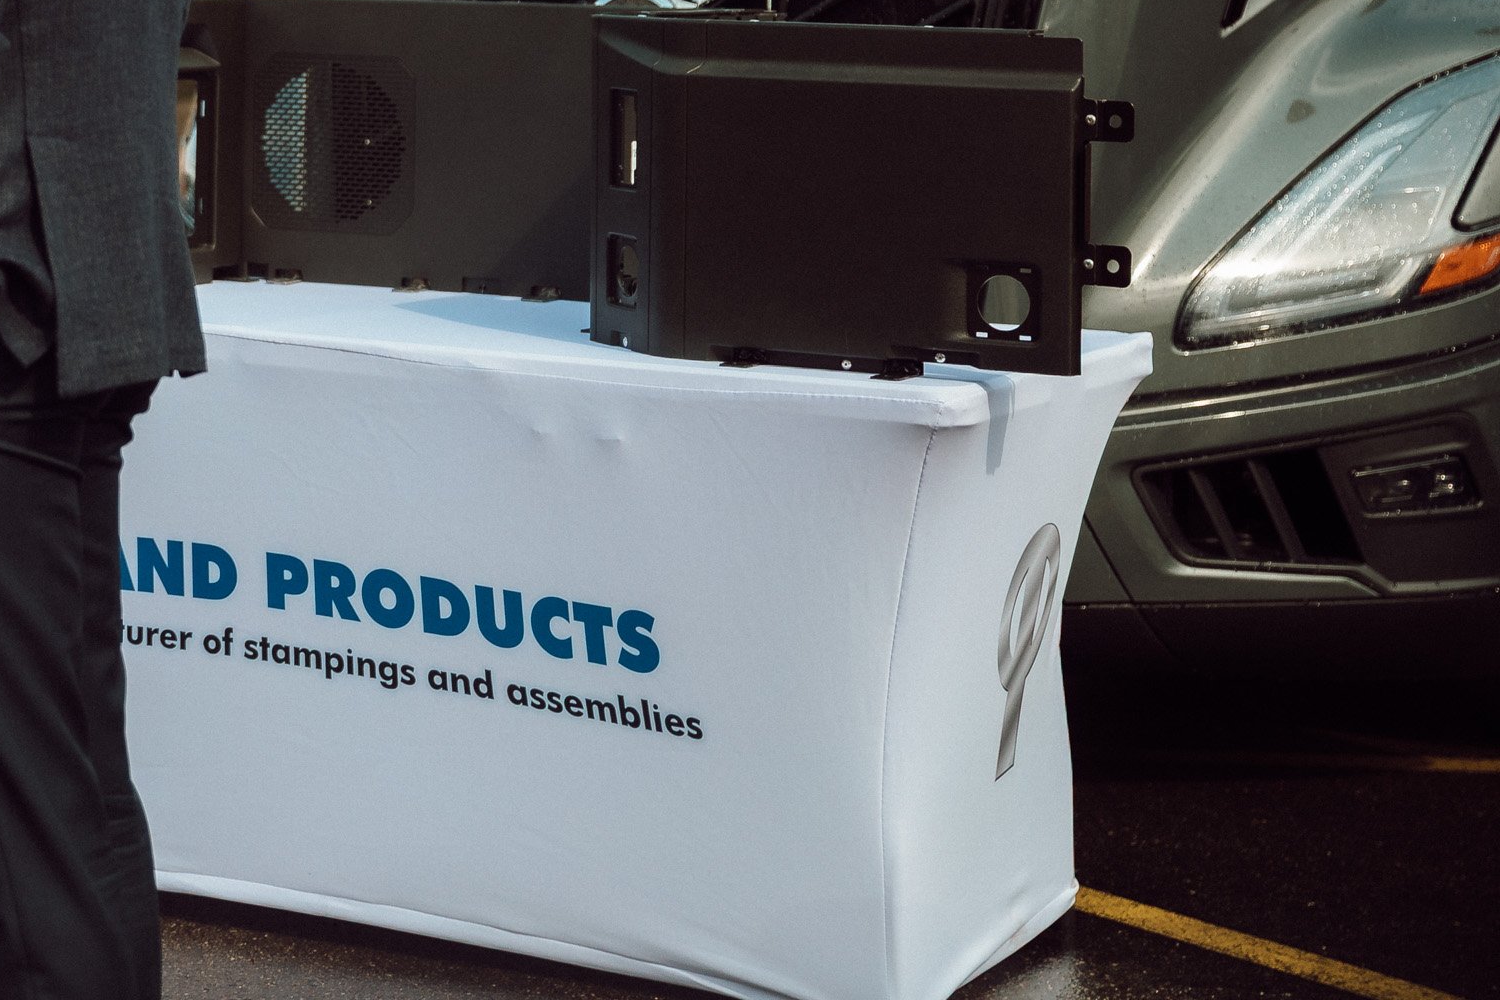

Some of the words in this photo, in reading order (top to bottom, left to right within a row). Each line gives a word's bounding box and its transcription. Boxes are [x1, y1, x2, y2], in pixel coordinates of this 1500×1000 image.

[265, 551, 661, 674] PRODUCTS
[202, 627, 234, 656] of
[243, 636, 416, 690] stampings
[427, 669, 495, 700] and
[506, 683, 703, 740] assemblies
